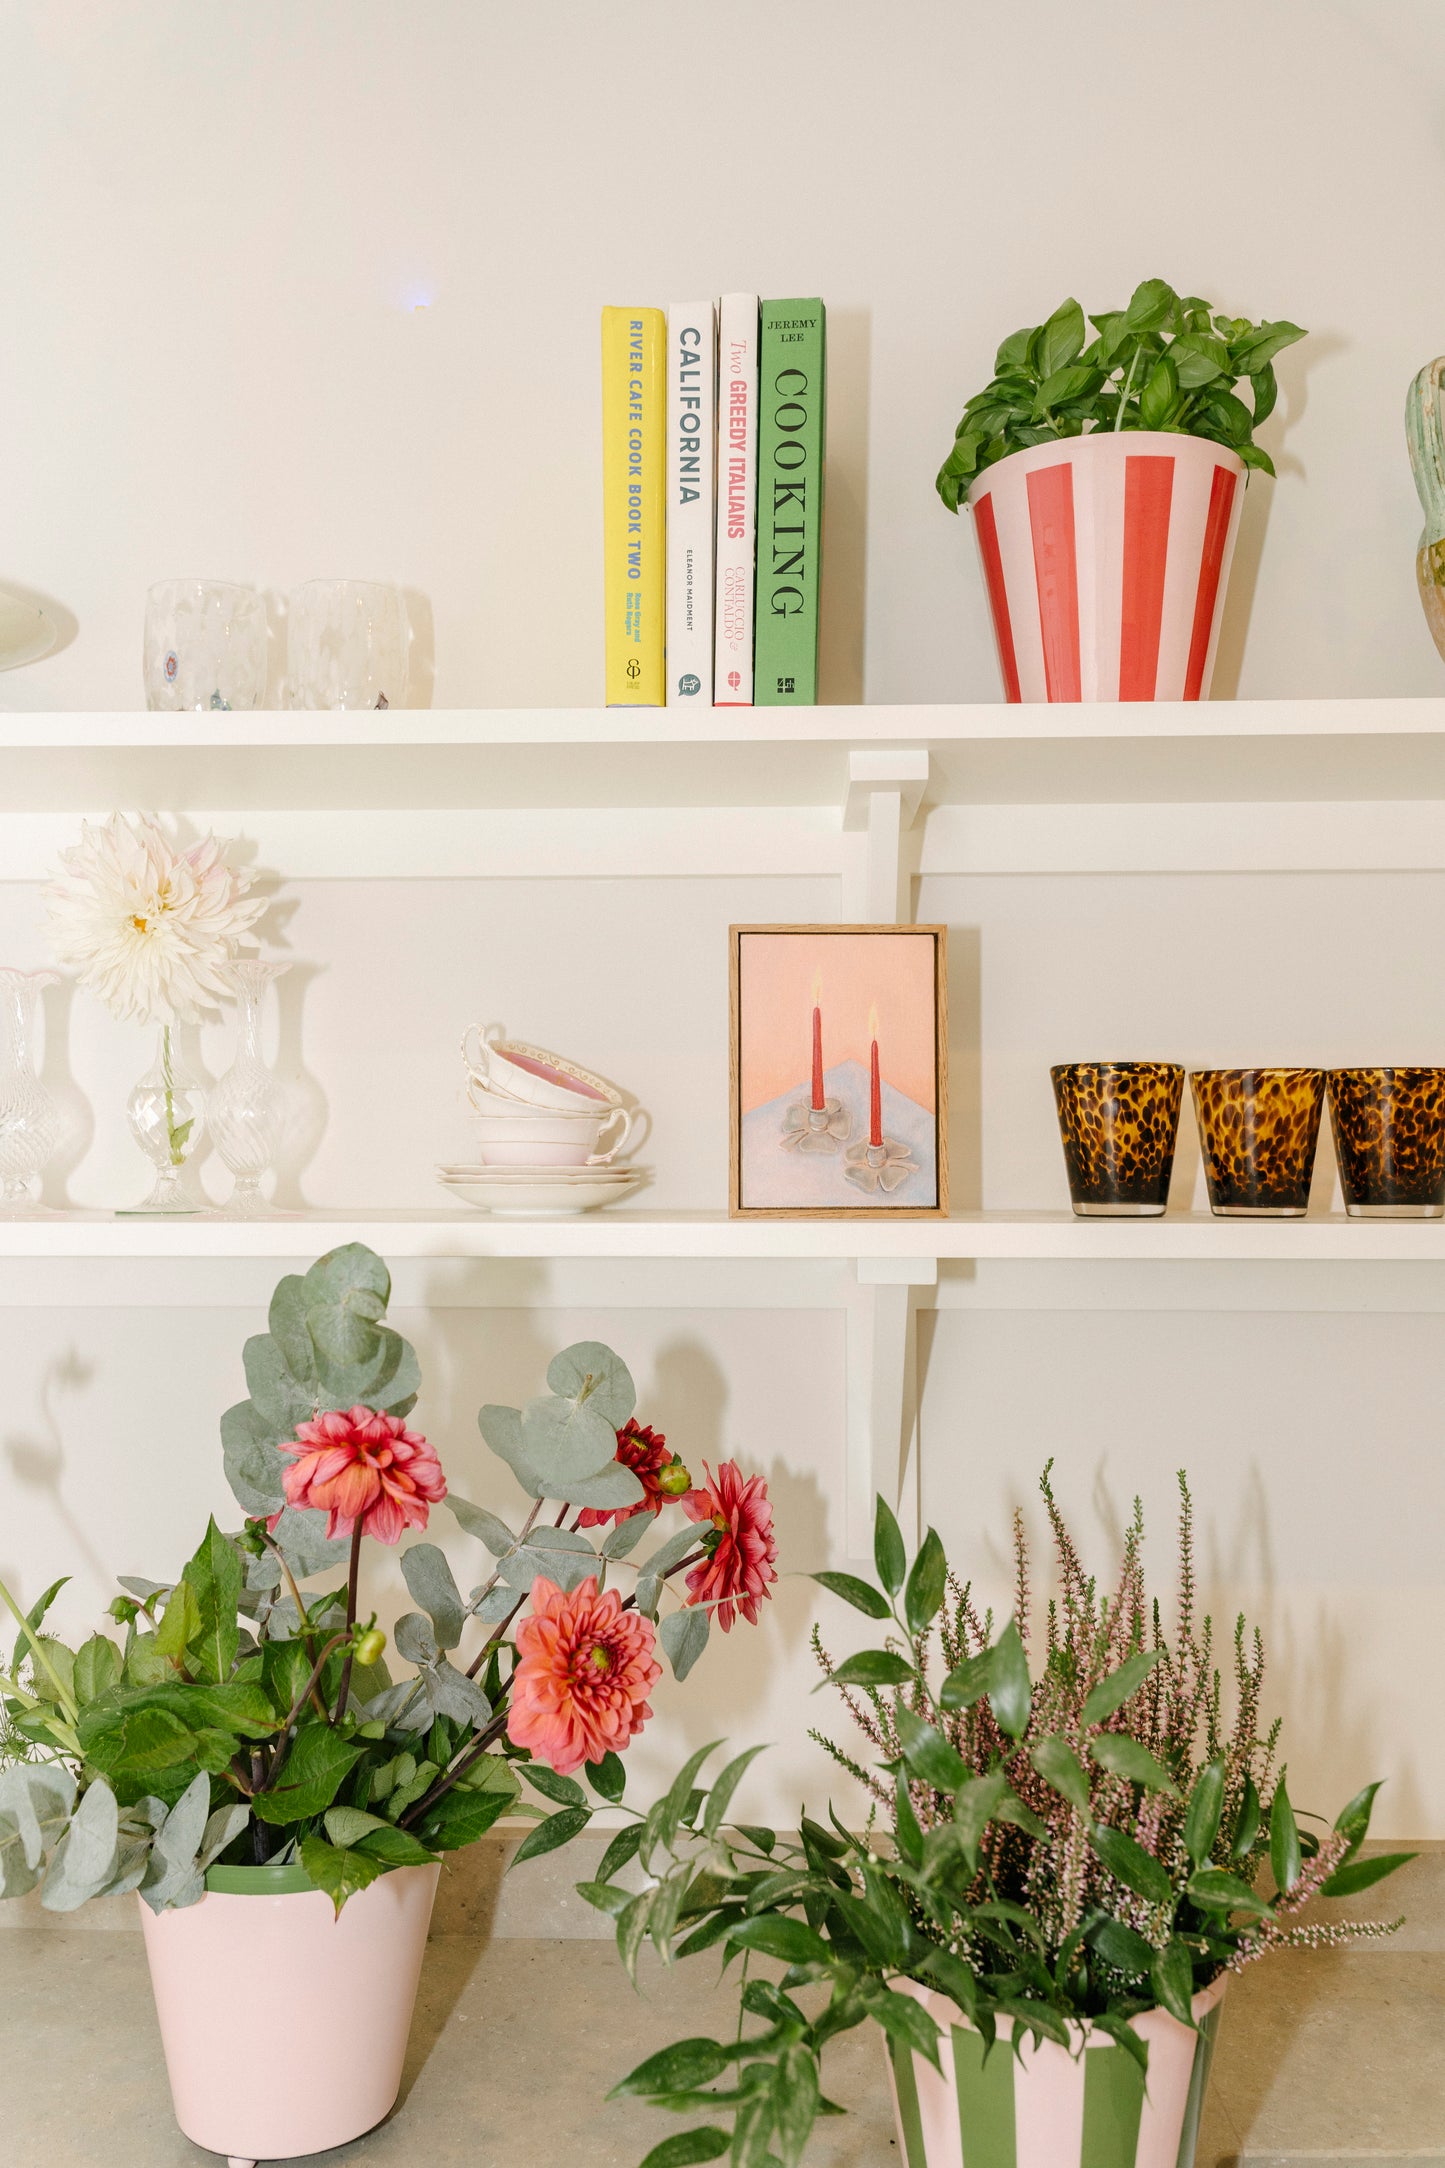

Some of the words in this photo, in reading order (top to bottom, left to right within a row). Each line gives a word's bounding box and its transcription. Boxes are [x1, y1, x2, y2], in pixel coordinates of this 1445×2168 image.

[629, 320, 643, 372] RIVER
[767, 319, 817, 330] JEREMY
[780, 333, 805, 343] LEE
[730, 340, 747, 374] Two
[628, 380, 643, 421] CAFE
[679, 327, 701, 505] CALIFORNIA
[729, 380, 748, 452] GREEDY
[628, 428, 642, 476] COOK
[627, 485, 642, 533] BOOK
[727, 457, 746, 539] ITALIANS
[770, 368, 808, 619] COOKING
[627, 541, 641, 579] TWO
[724, 567, 734, 640] CONTALDO
[734, 566, 745, 641] CARLUCCIO
